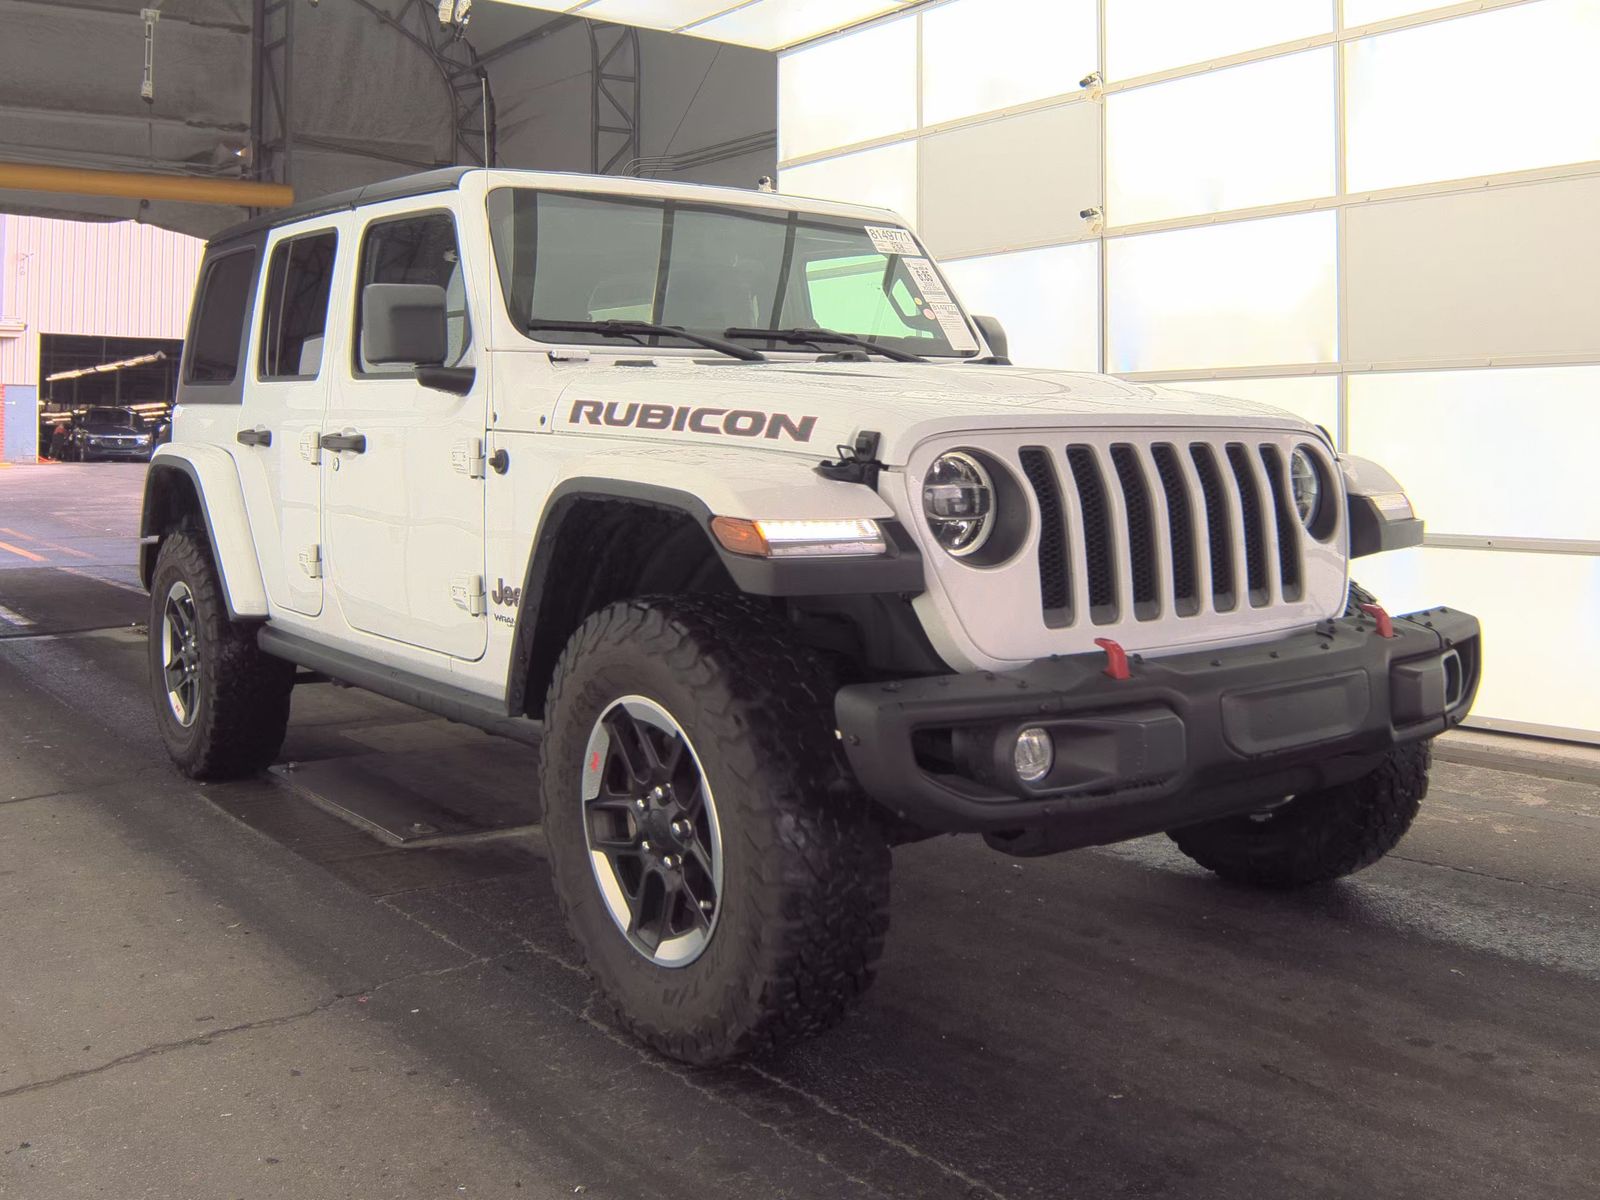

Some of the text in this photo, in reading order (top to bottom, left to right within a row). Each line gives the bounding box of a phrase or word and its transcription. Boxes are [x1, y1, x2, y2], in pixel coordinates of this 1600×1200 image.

[868, 228, 911, 241] 8149771
[568, 399, 818, 443] RUBICON
[492, 577, 521, 607] Jee
